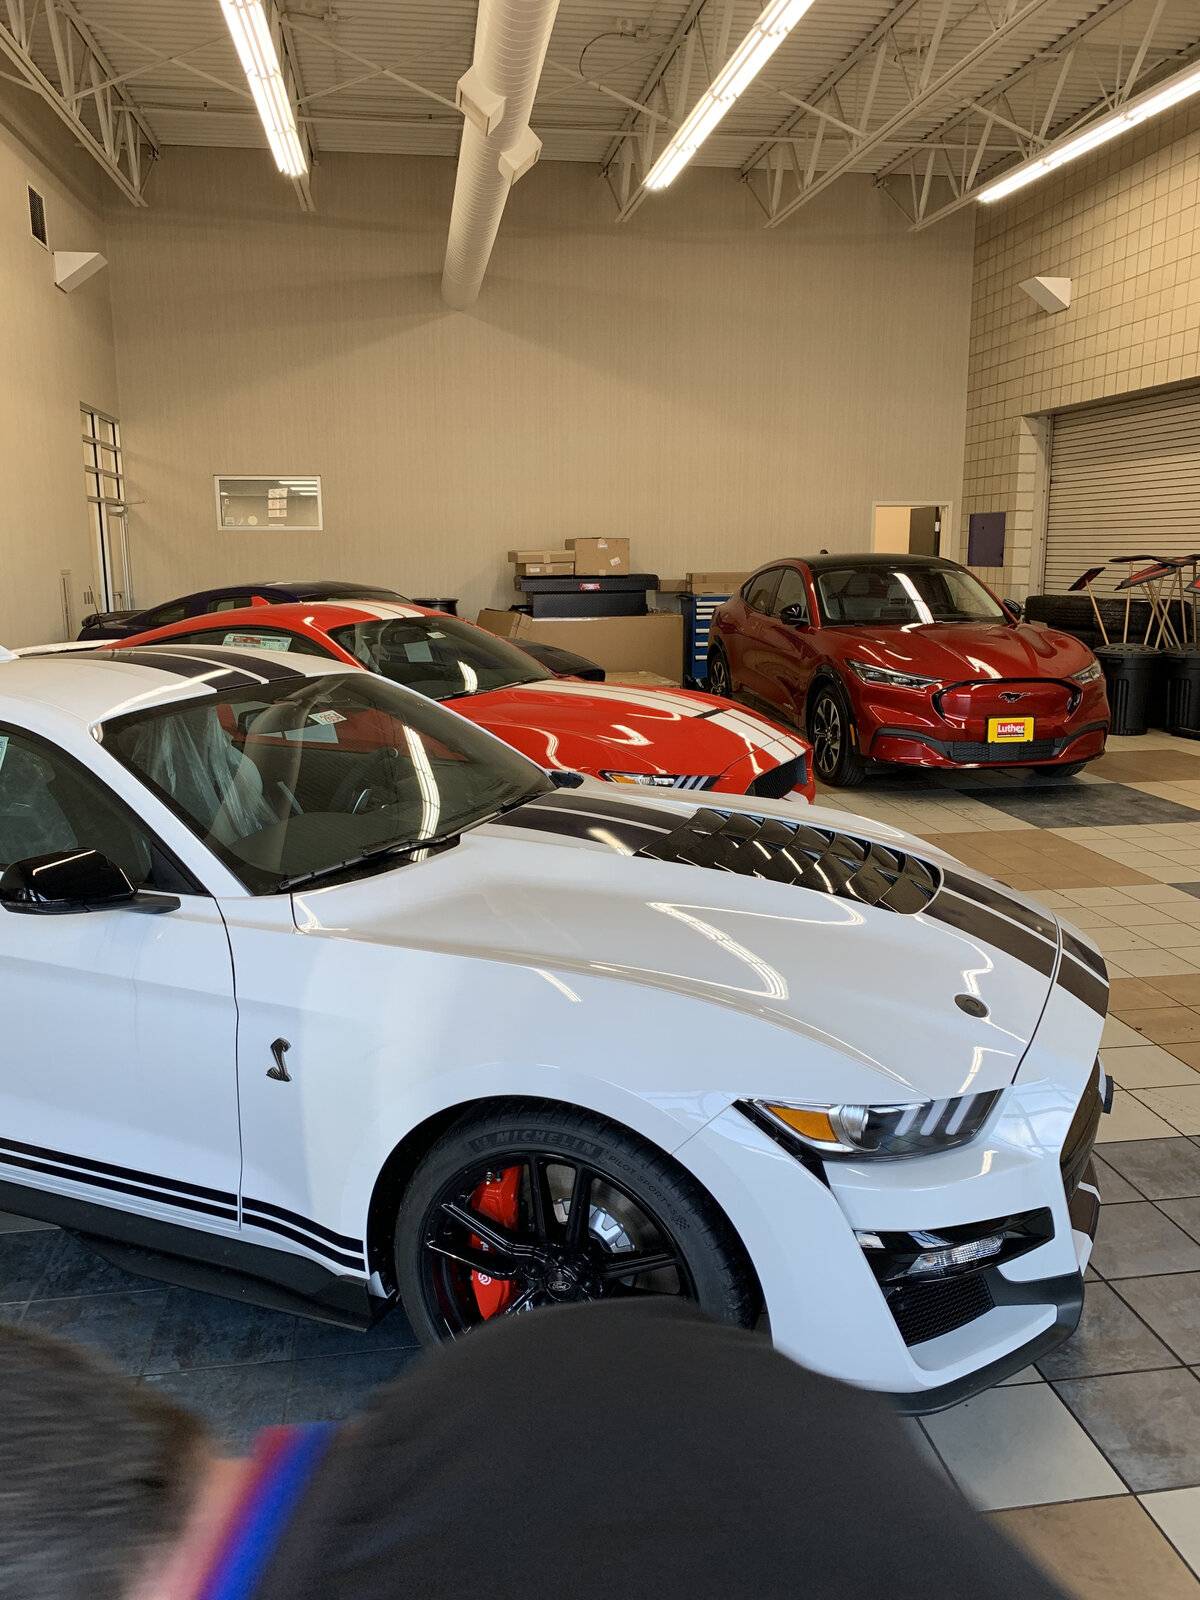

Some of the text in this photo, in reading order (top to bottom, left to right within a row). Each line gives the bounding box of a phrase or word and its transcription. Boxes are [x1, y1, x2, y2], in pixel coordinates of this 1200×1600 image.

[997, 724, 1024, 733] Luther
[495, 1130, 598, 1155] MICHELIN
[608, 1155, 637, 1174] PILOT
